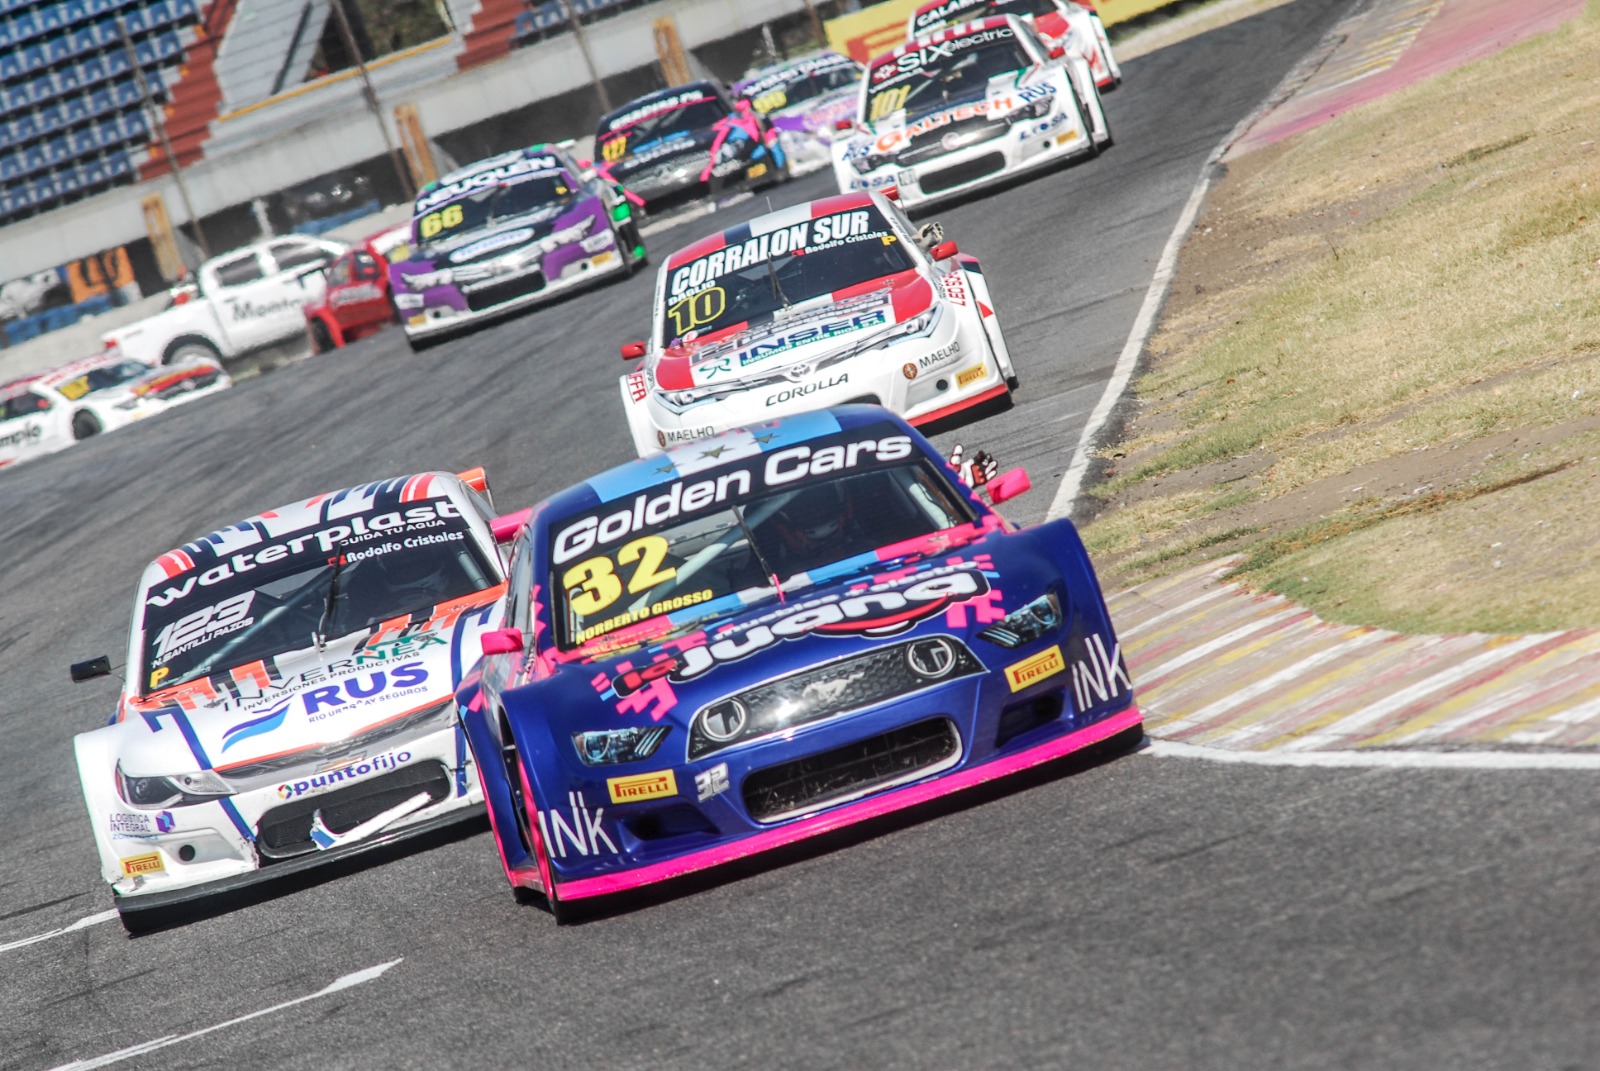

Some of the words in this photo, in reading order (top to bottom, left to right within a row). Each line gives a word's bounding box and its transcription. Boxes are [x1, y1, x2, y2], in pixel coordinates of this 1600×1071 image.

[420, 204, 464, 239] 66
[671, 222, 809, 296] CORRALON
[814, 210, 870, 242] SUR
[805, 240, 844, 255] Rodolfo
[846, 230, 889, 245] Cristales
[881, 235, 897, 247] P
[668, 280, 716, 307] DAGLIO
[668, 286, 726, 337] 10
[743, 341, 793, 365] INSUMOS
[796, 332, 832, 347] ENTRE
[834, 325, 860, 336] RIOS
[919, 341, 960, 368] MAELHO
[765, 373, 849, 407] COROLLA
[667, 426, 715, 442] MAELHO
[552, 469, 750, 565] Golden
[764, 436, 912, 486] Cars
[384, 527, 404, 535] TU
[406, 519, 446, 531] AGUA
[146, 501, 461, 607] waterplast
[346, 541, 402, 563] Rodolfo
[404, 531, 465, 548] Cristales
[562, 535, 677, 617] 32
[152, 590, 256, 659] 123
[213, 616, 254, 639] PAZOS
[575, 607, 650, 645] NORBERTO
[652, 589, 713, 616] GROSSO
[680, 571, 978, 677] juana
[149, 667, 169, 688] P
[244, 679, 329, 711] INVERSIONES
[329, 652, 420, 679] PRODUCTIVAS
[1013, 653, 1059, 685] PIRELLI
[301, 661, 429, 716] RUS
[379, 686, 429, 703] SEGUROS
[294, 751, 411, 796] puntofijo
[613, 776, 669, 798] PIRELLI
[694, 762, 730, 803] 32
[110, 813, 150, 823] LOGISTICA
[110, 823, 151, 832] INTEGRAL
[125, 855, 160, 874] PIRELLI
